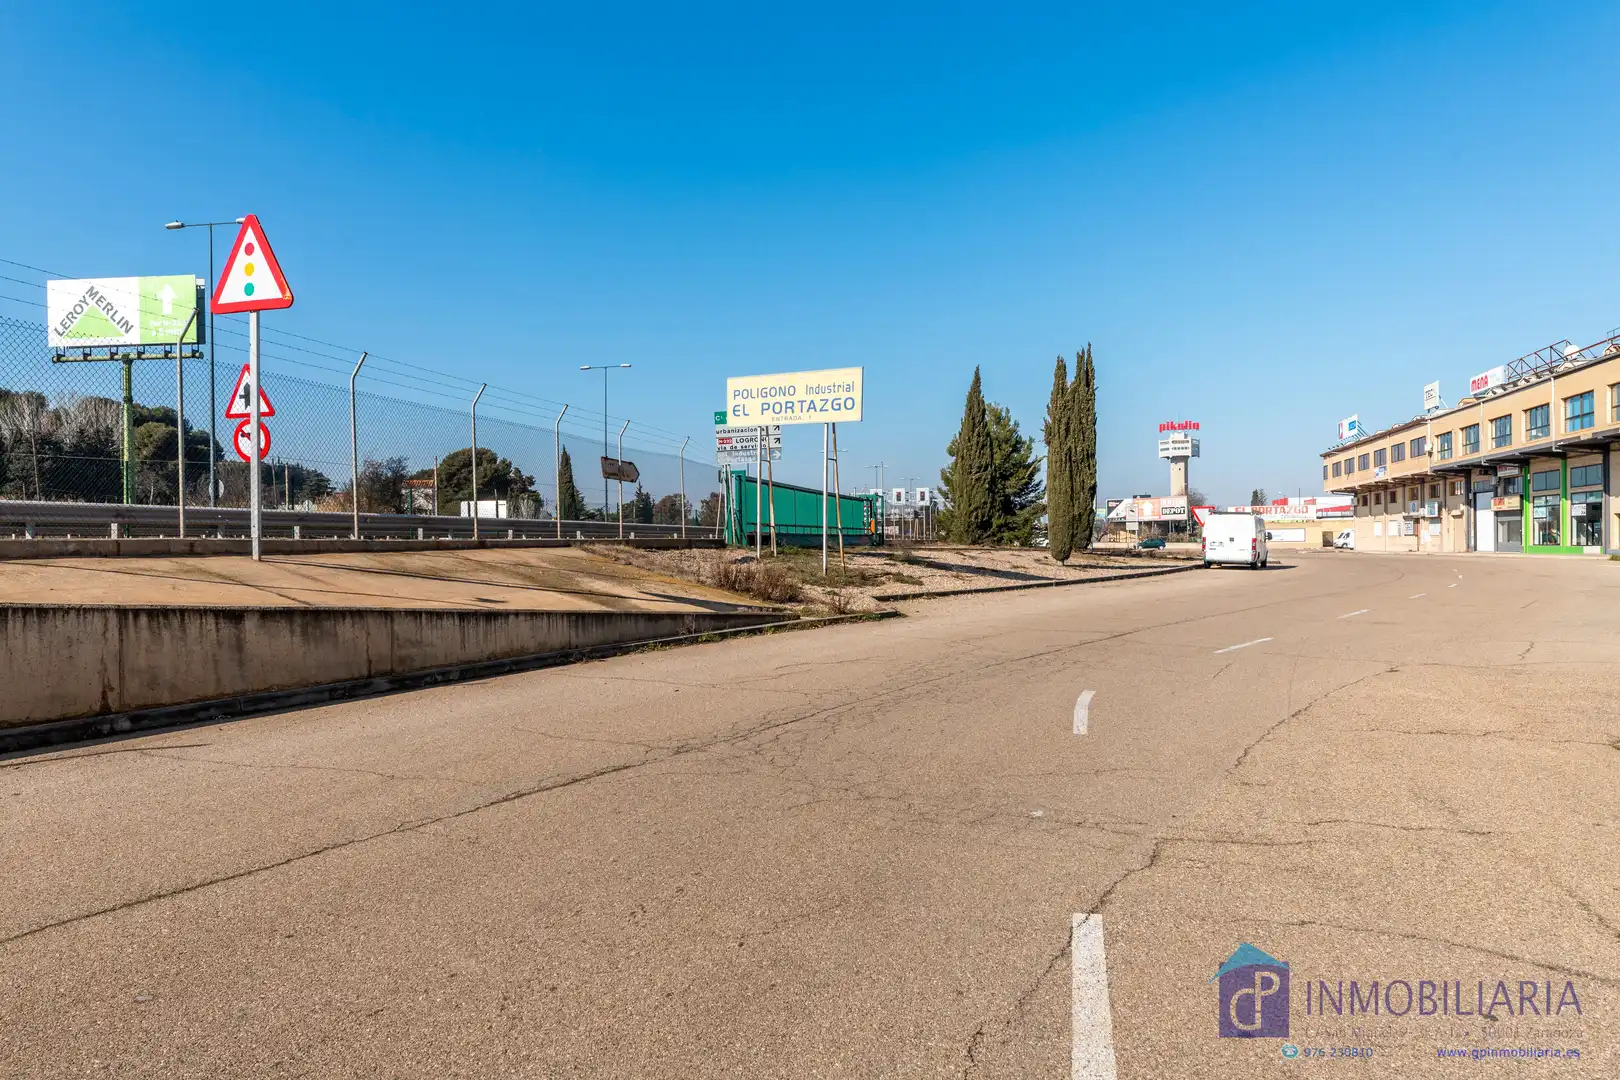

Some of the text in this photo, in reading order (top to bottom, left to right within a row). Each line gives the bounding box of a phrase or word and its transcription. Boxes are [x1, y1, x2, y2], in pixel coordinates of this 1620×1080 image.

[54, 285, 134, 337] LEROY MERLIN
[733, 380, 855, 401] POLIGONO Industrial
[732, 396, 857, 417] EL PORTAZGO
